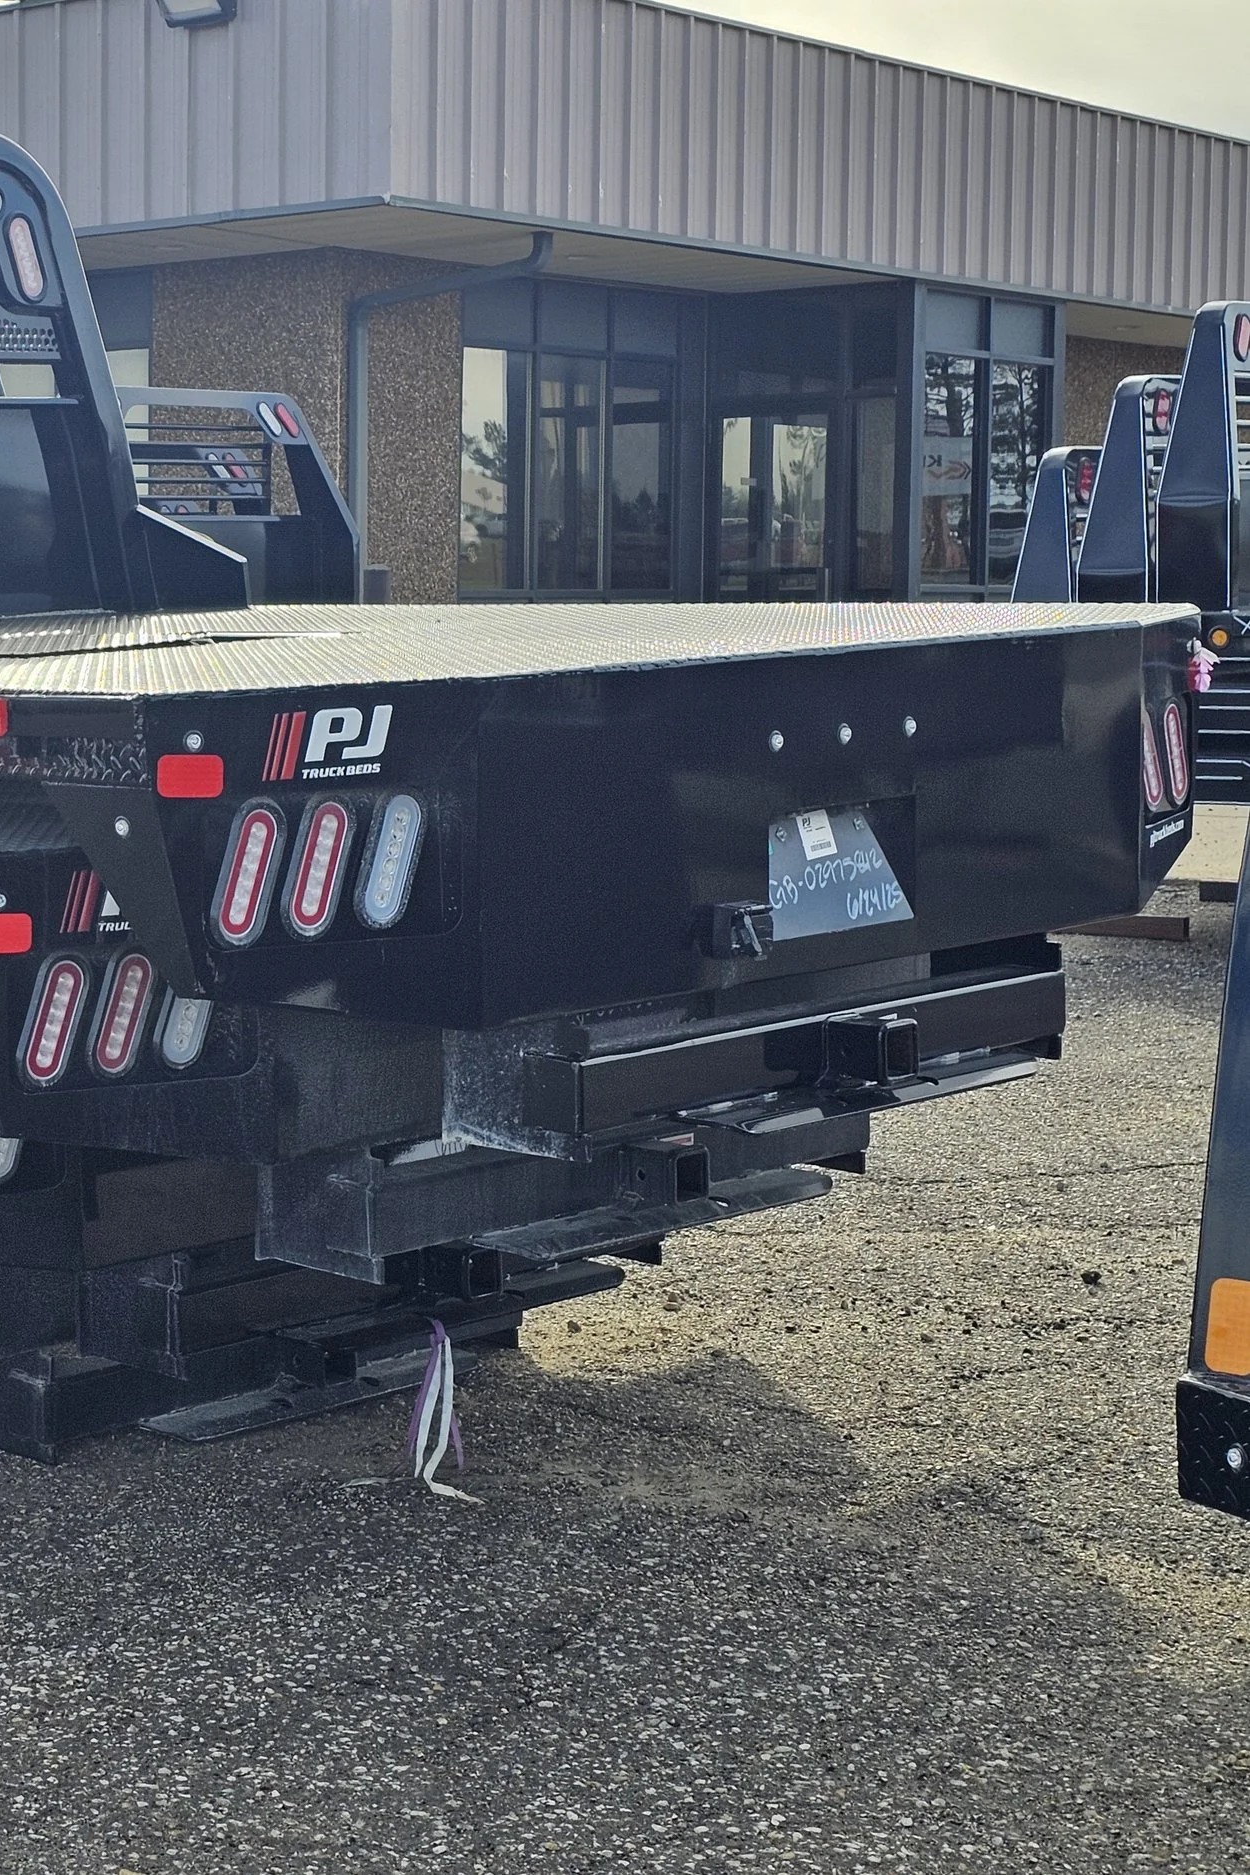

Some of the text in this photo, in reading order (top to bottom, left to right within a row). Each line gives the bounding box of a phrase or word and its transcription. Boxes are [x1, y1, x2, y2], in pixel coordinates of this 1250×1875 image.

[304, 705, 393, 762] PJ
[302, 763, 381, 779] TRUCK BEDS
[802, 817, 811, 827] PJ
